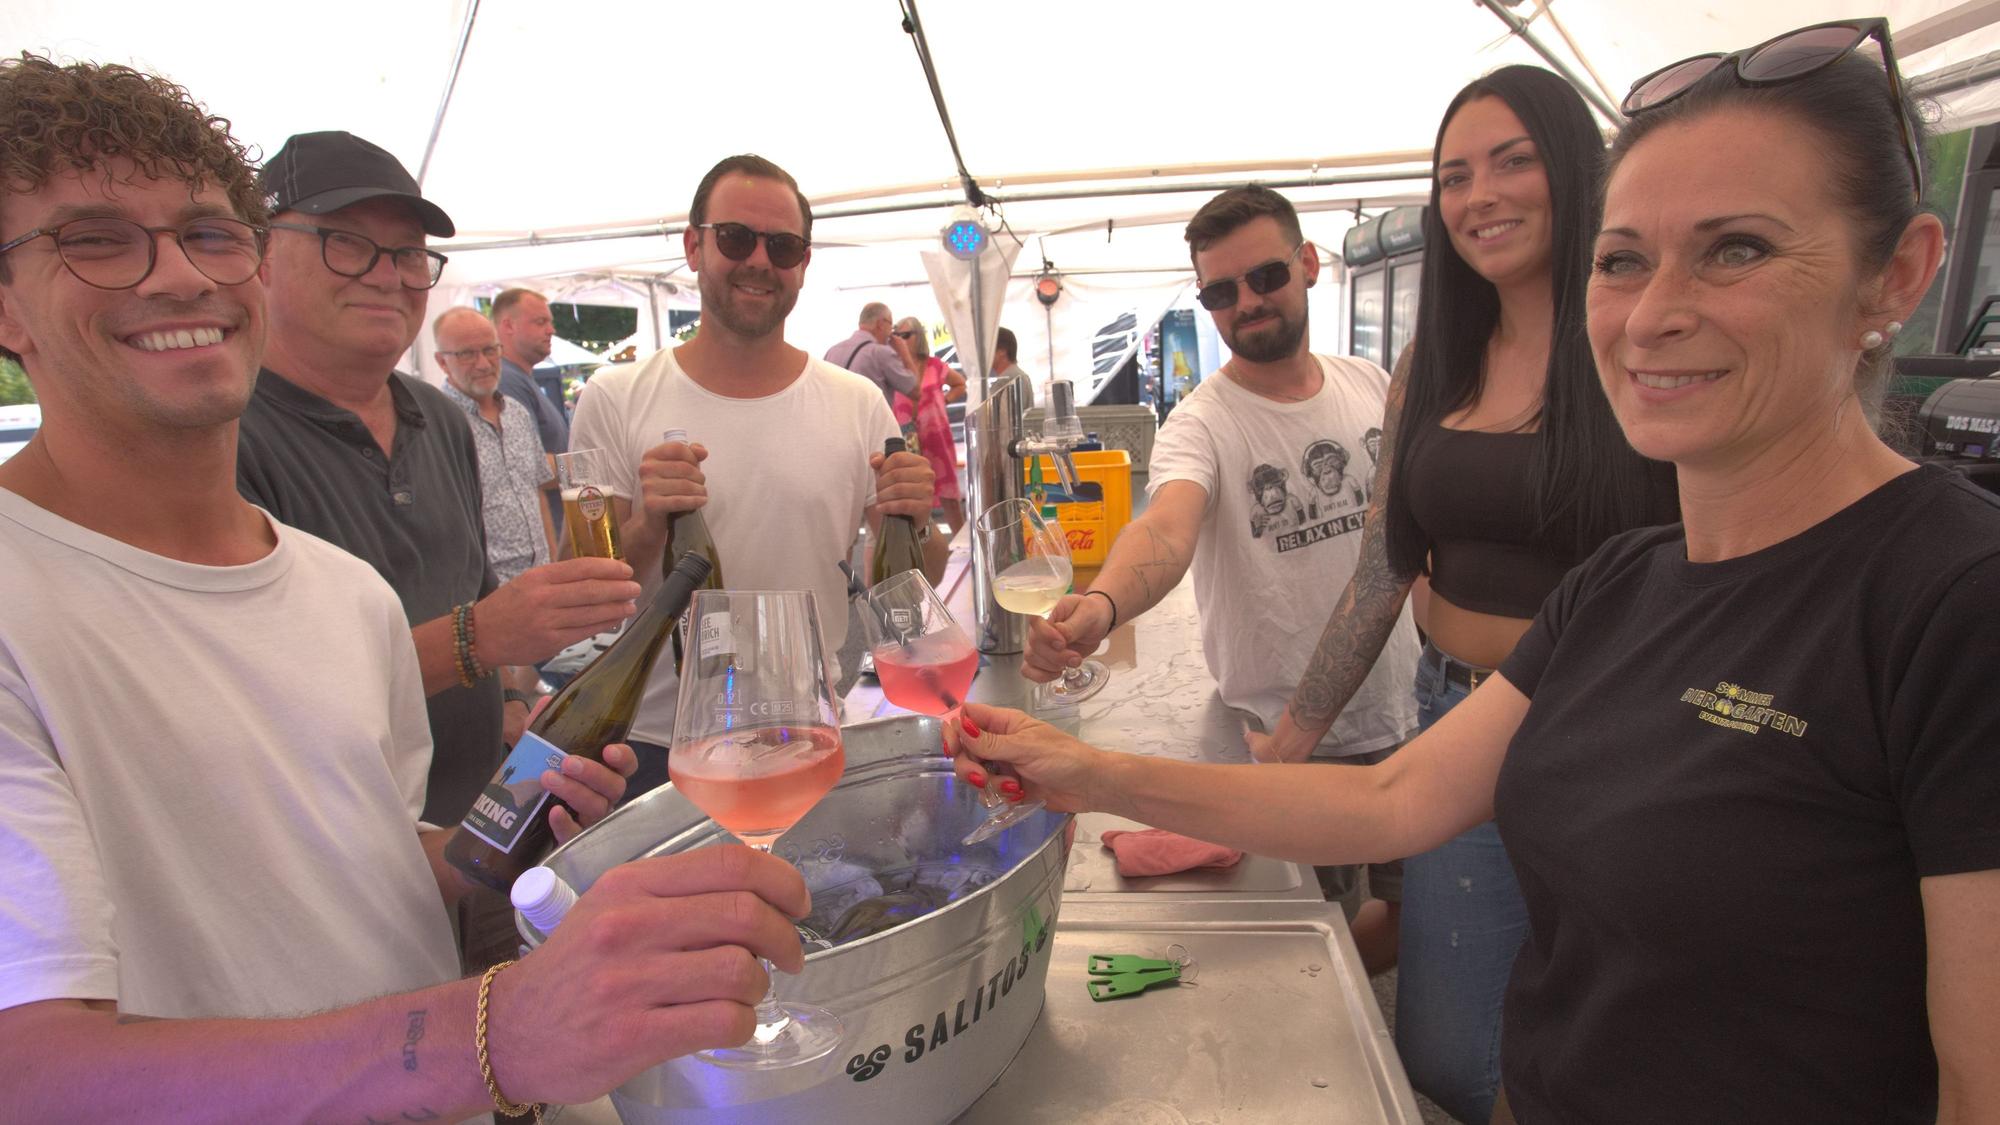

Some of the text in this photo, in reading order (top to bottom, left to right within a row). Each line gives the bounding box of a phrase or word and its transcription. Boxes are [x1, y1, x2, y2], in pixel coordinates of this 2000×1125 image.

[1278, 526, 1326, 551] RELAX
[1328, 520, 1345, 535] IN
[1680, 688, 1808, 737] BIER GARTEN
[904, 942, 1032, 1063] SALITOS
